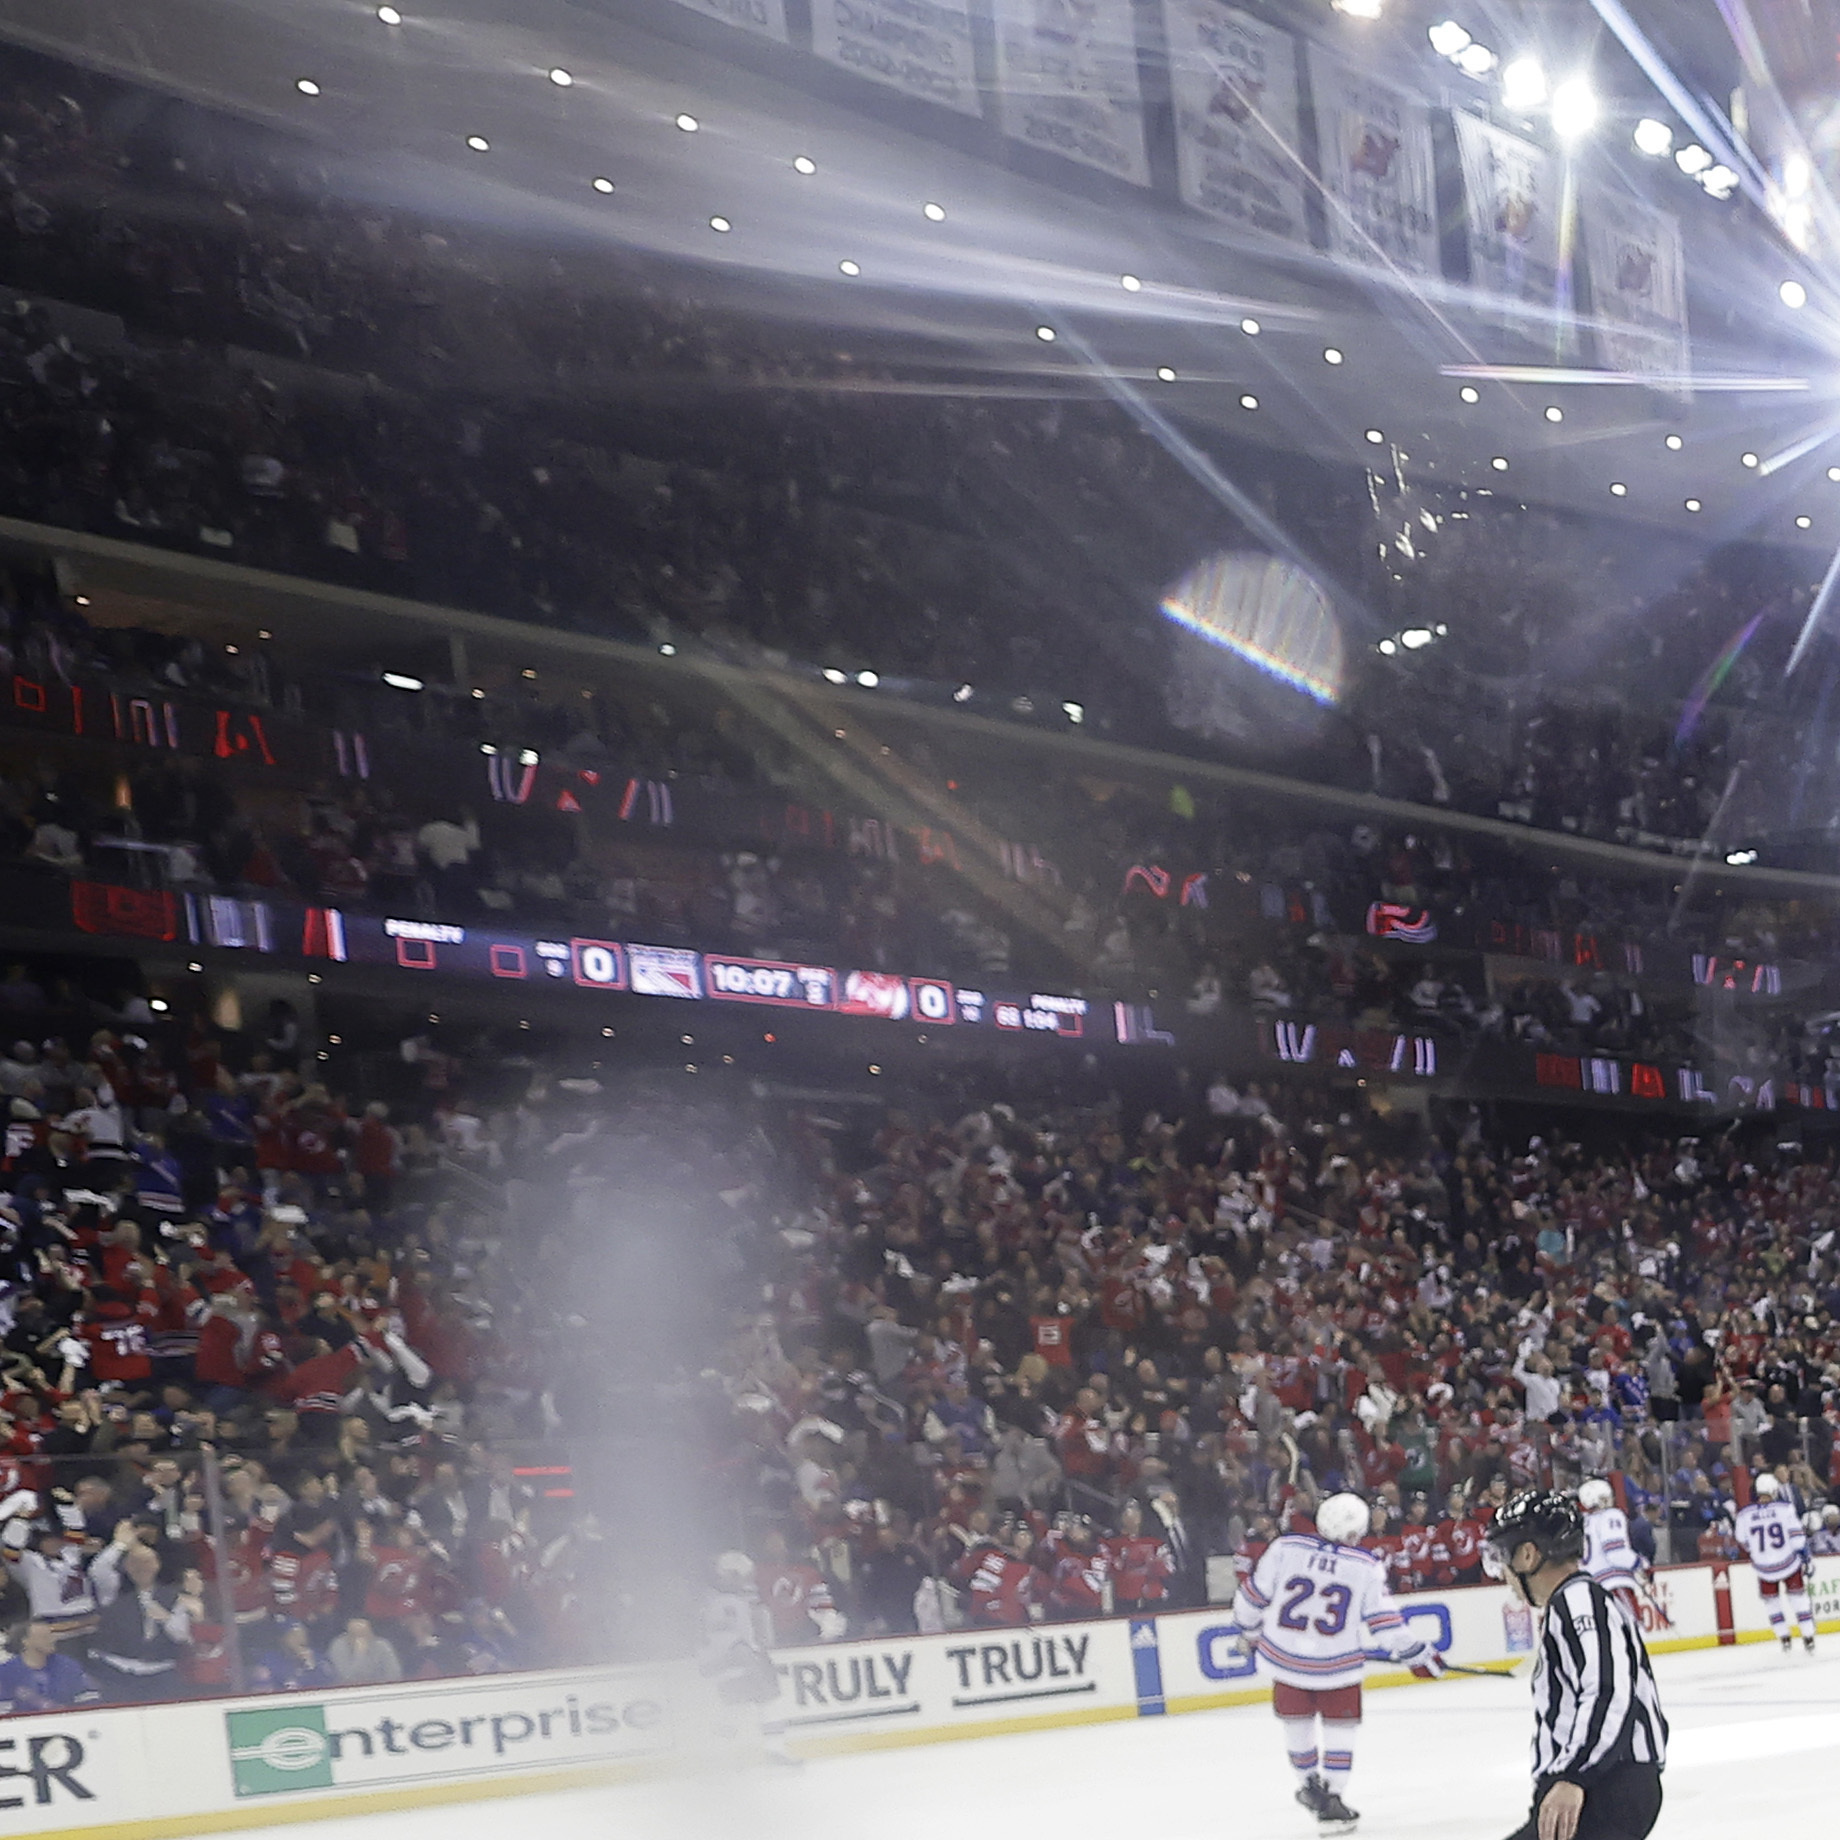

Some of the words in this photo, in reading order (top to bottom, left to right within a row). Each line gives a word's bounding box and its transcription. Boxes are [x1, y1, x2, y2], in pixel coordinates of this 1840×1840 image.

[583, 947, 613, 982] 0
[710, 960, 793, 997] 10:07
[918, 984, 943, 1017] 0
[1750, 1522, 1785, 1553] 79
[1307, 1553, 1338, 1575] FOX
[1278, 1577, 1354, 1637] 23
[947, 1633, 1089, 1689] TRULY
[262, 1697, 665, 1772] enterprise
